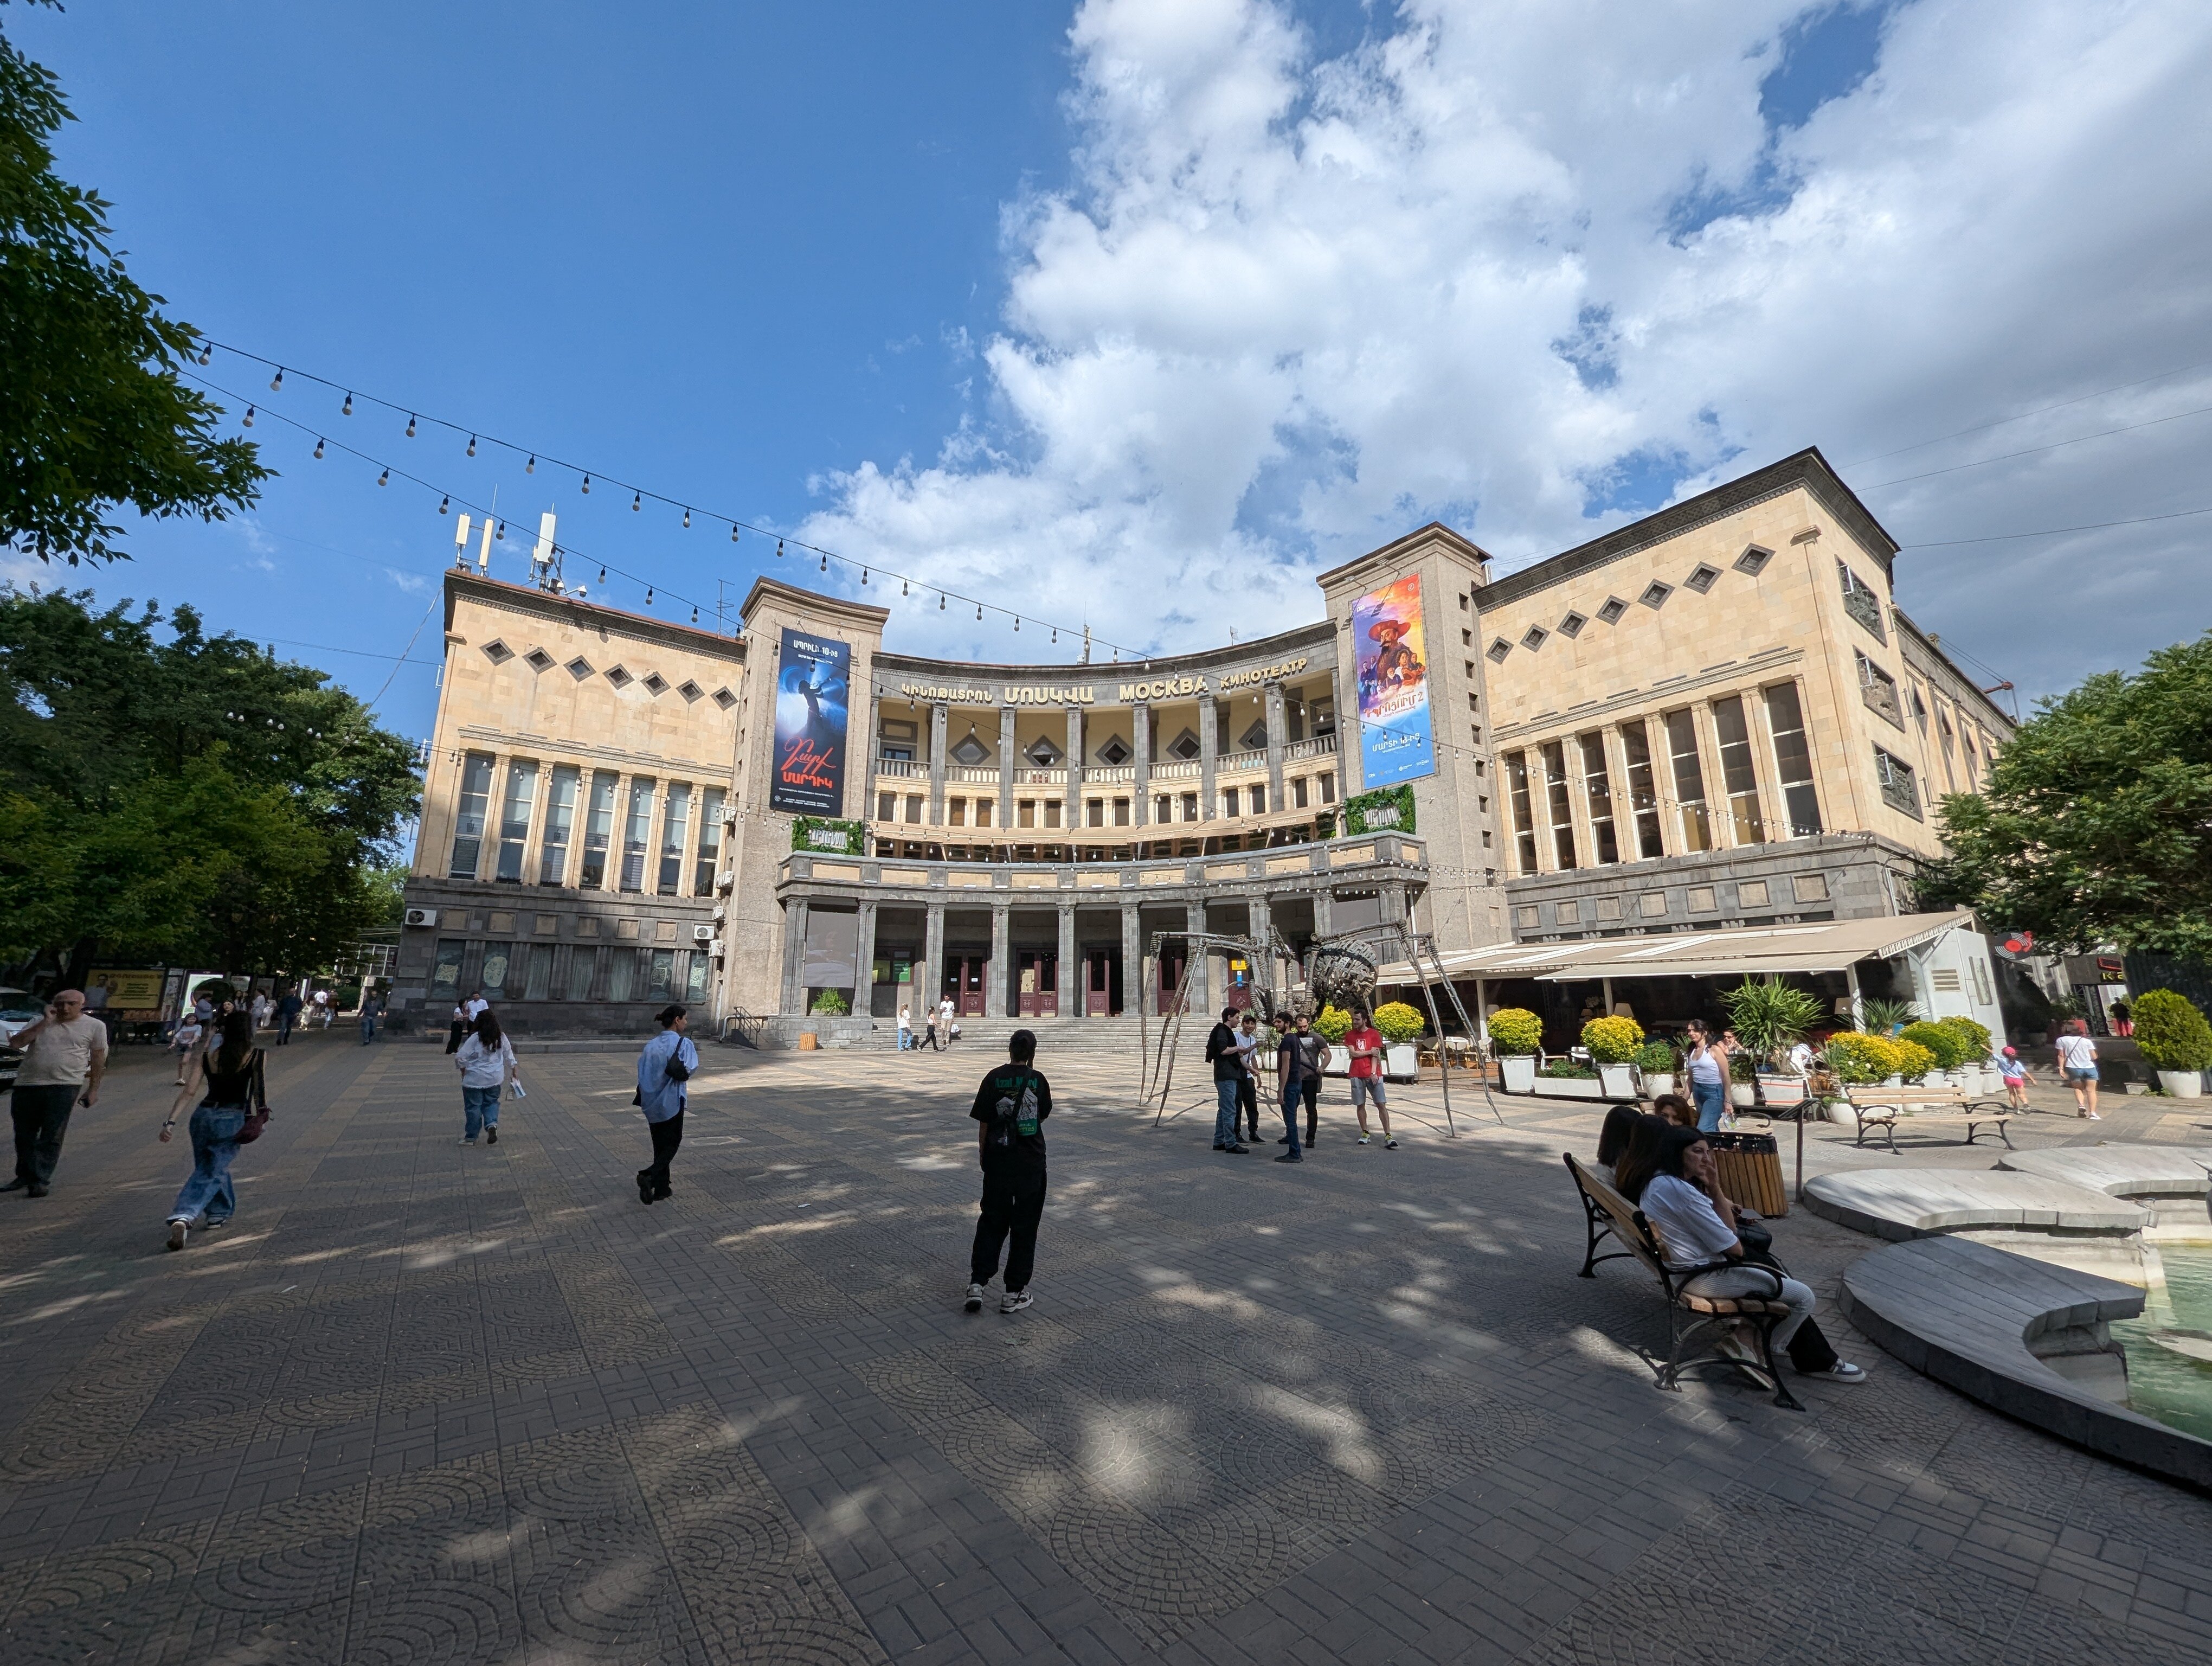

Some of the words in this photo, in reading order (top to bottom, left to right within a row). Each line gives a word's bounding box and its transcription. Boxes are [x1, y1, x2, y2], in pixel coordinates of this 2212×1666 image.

[1119, 675, 1209, 700] МОСКВА
[1220, 657, 1308, 688] КИНОТЕАТР
[902, 683, 993, 702] ԿԻՆՈԹԱՏՐՈՆ
[1005, 686, 1094, 703] ՄՈՍԿՎԱ
[1418, 691, 1424, 702] 2
[1372, 739, 1398, 752] ՄԱՐՏԻ
